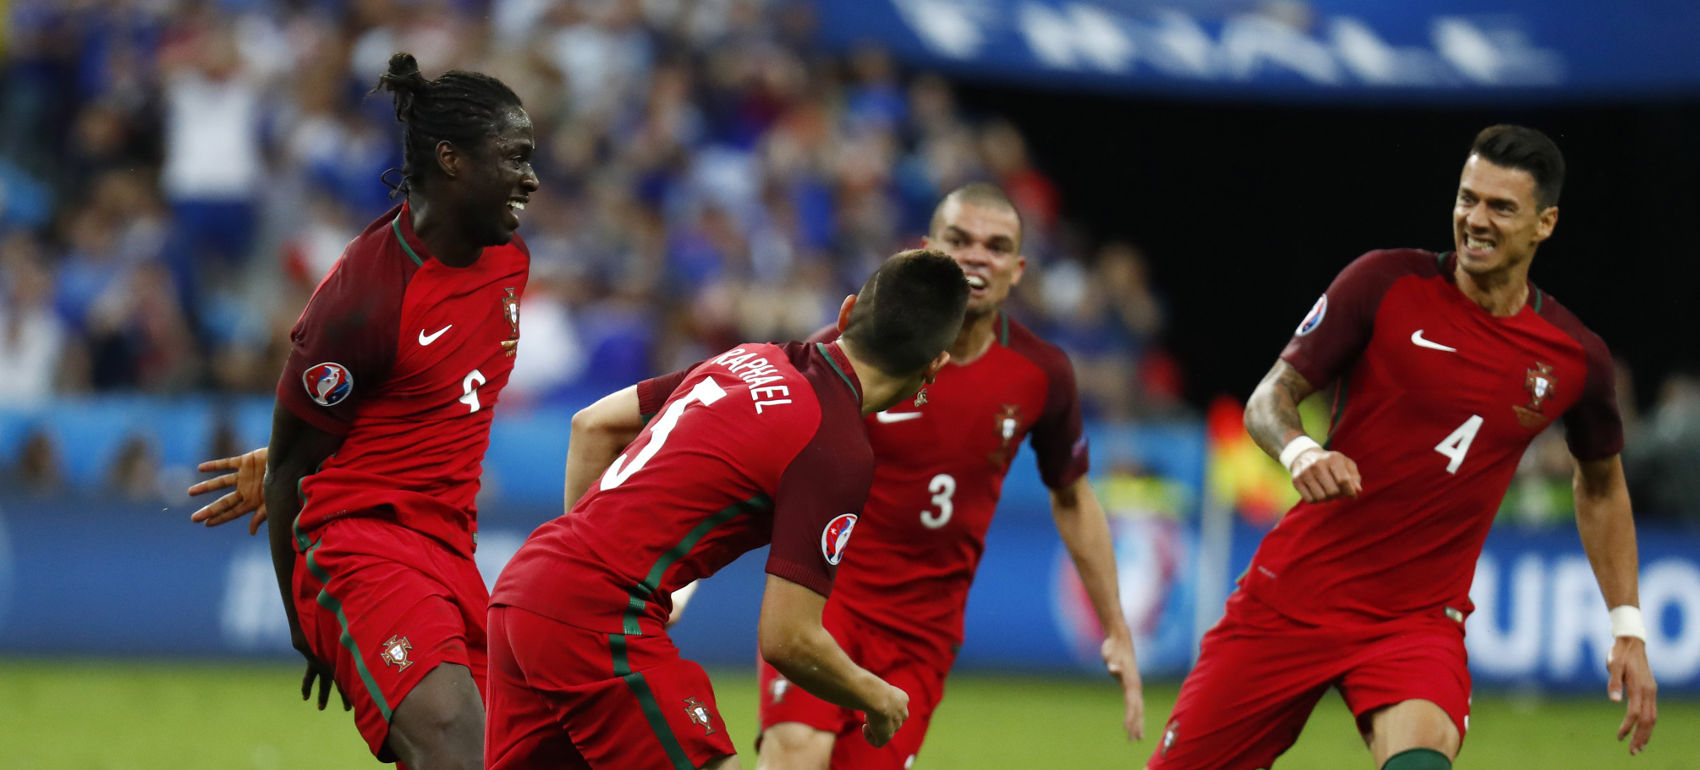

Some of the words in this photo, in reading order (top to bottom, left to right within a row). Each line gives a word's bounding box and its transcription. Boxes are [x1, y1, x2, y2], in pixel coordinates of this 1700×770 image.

[459, 368, 487, 414] 9
[711, 347, 793, 416] RAPHAEL
[1434, 414, 1484, 475] 4
[919, 473, 957, 530] 3
[1464, 552, 1700, 684] URO
